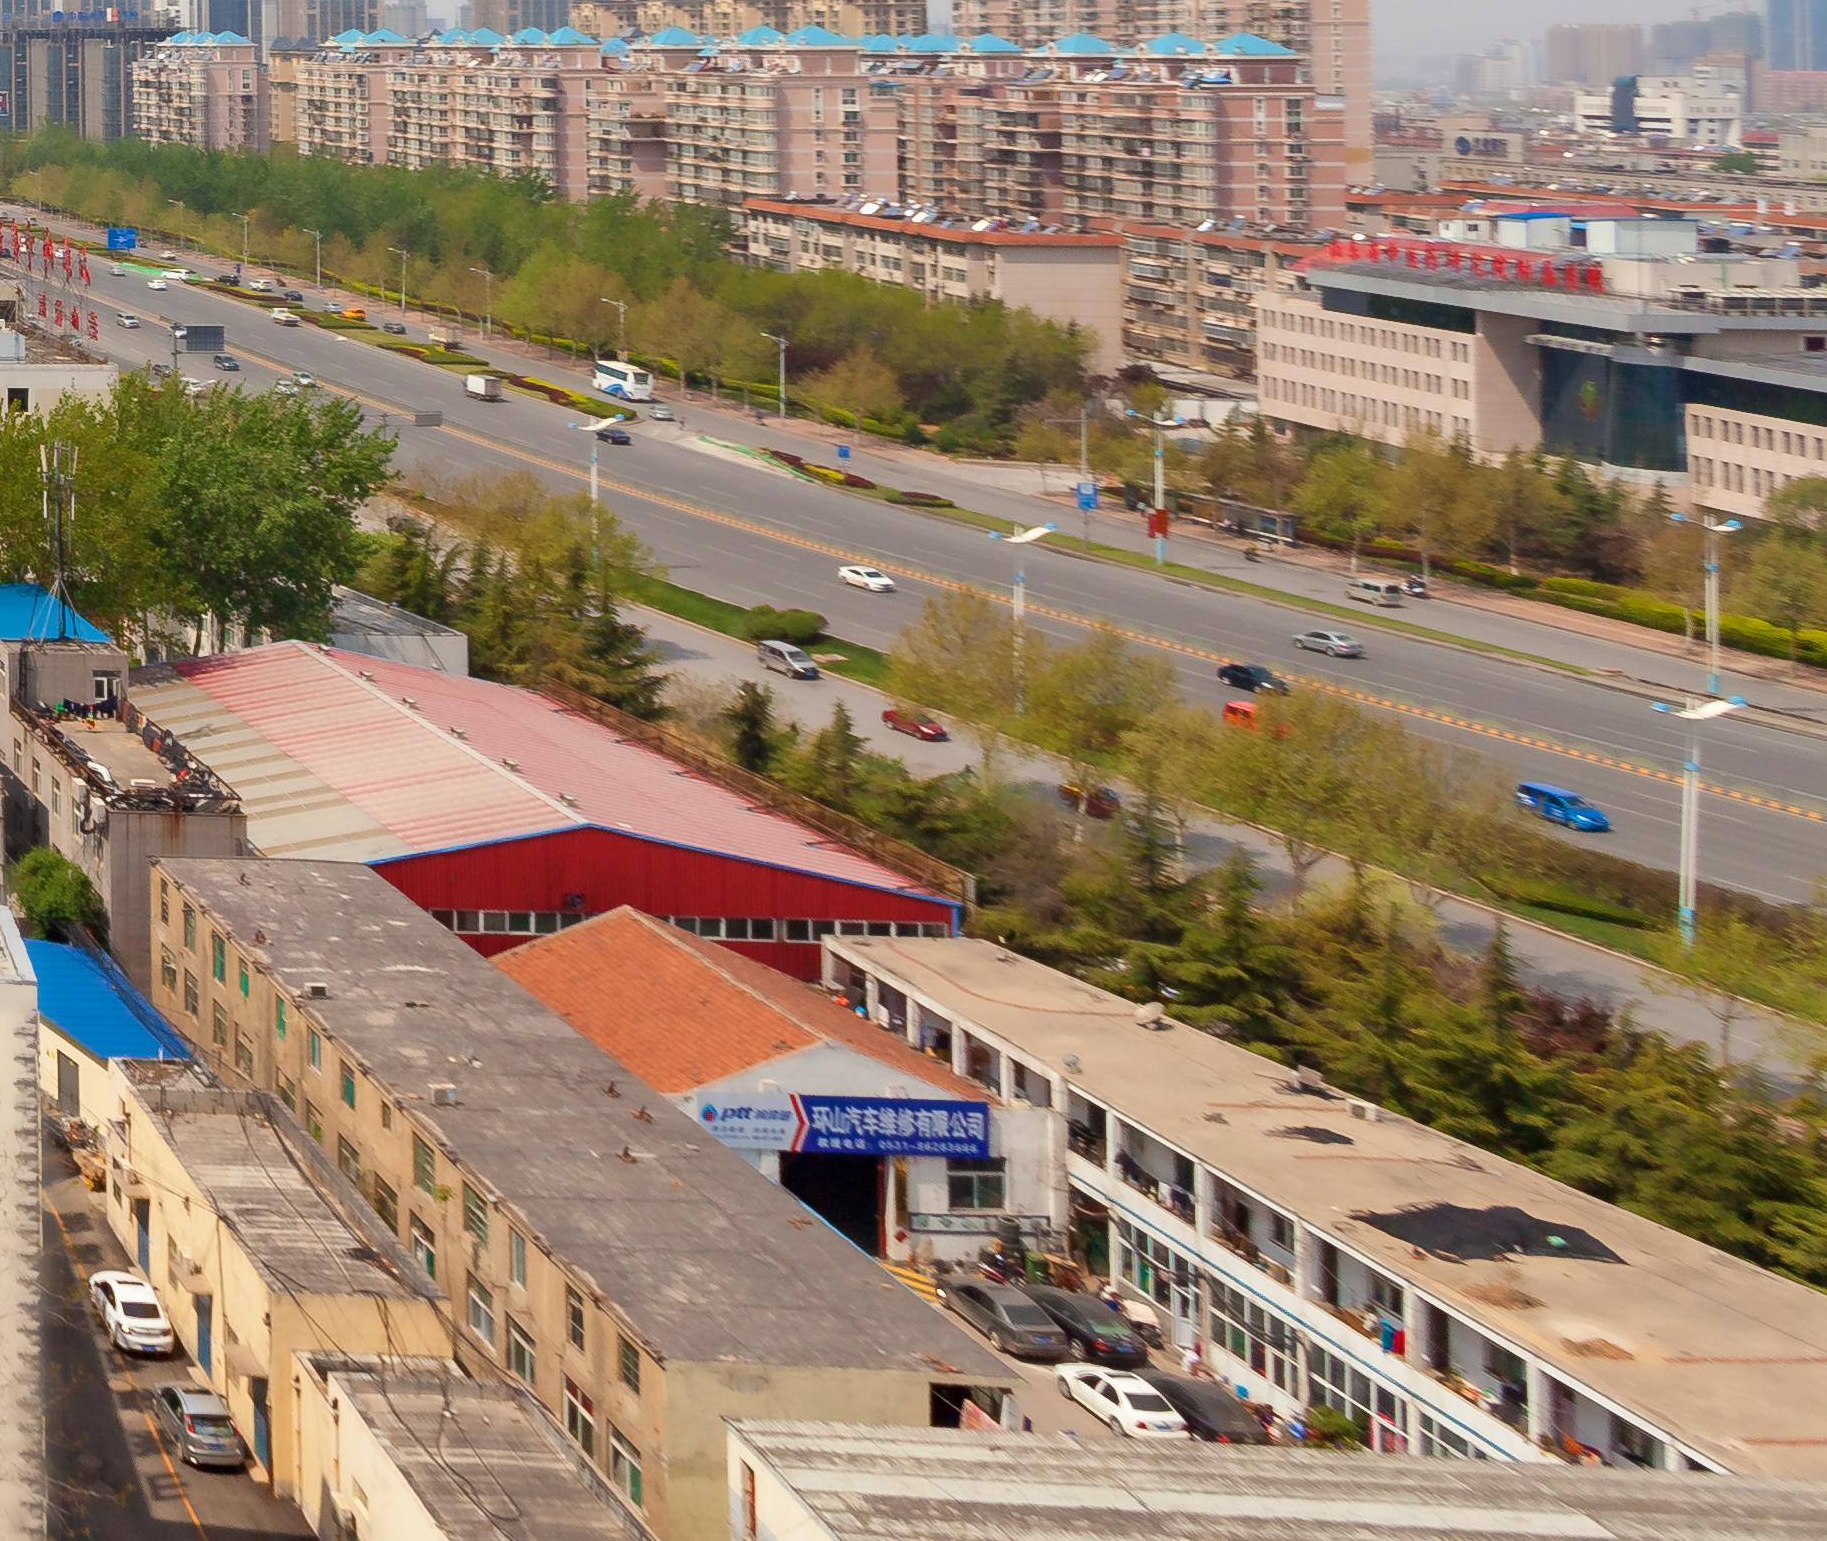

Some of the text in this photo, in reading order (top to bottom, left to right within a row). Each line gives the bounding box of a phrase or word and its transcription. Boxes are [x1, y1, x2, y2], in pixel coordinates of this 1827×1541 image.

[811, 1105, 984, 1140] 环山汽车维修有限公司
